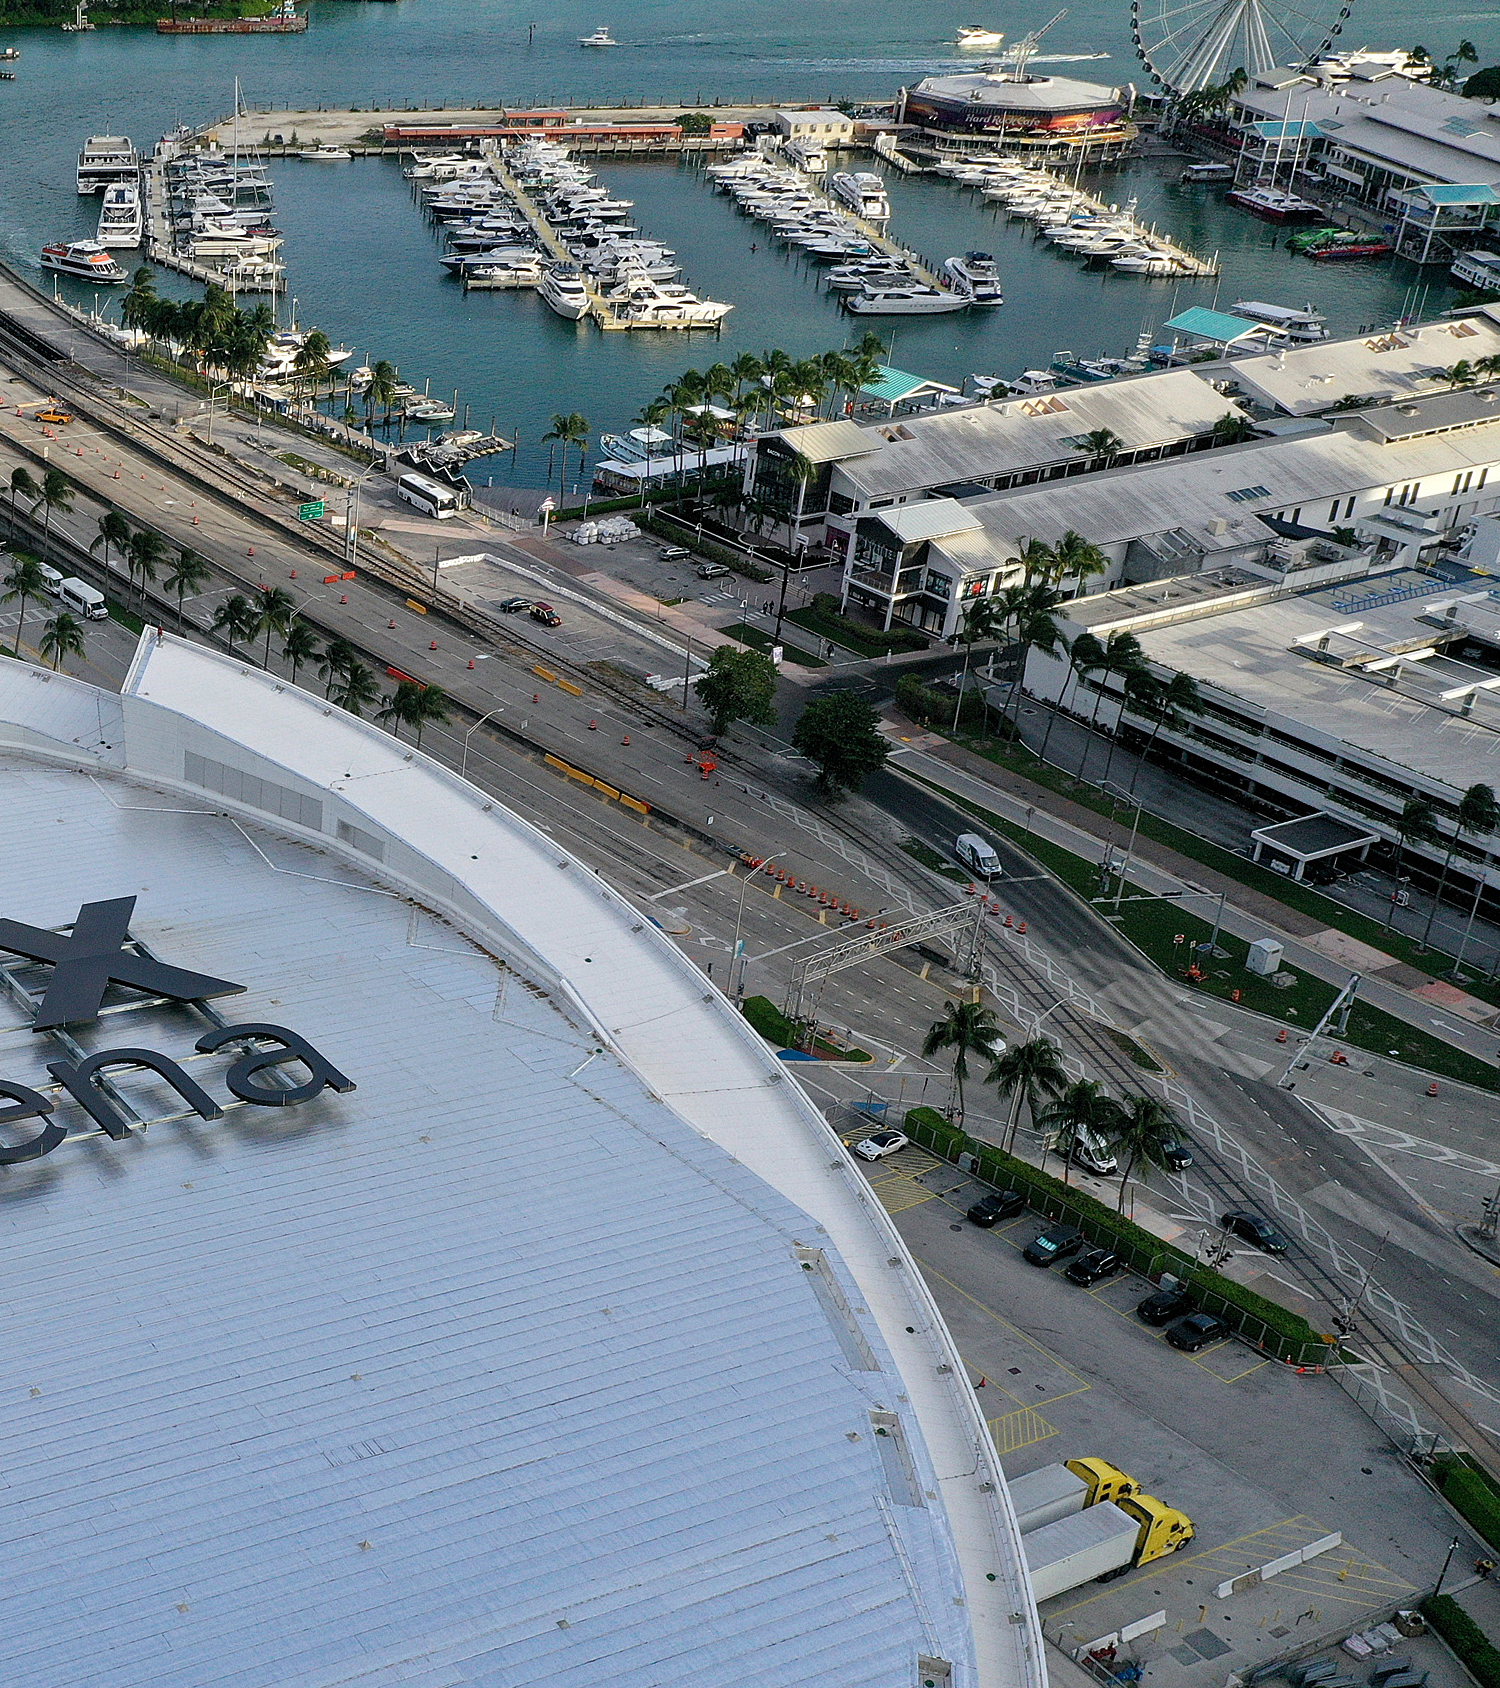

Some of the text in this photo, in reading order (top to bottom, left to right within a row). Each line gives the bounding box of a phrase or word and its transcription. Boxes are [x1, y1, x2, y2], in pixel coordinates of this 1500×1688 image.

[965, 113, 1041, 127] Hard Rock Cafe
